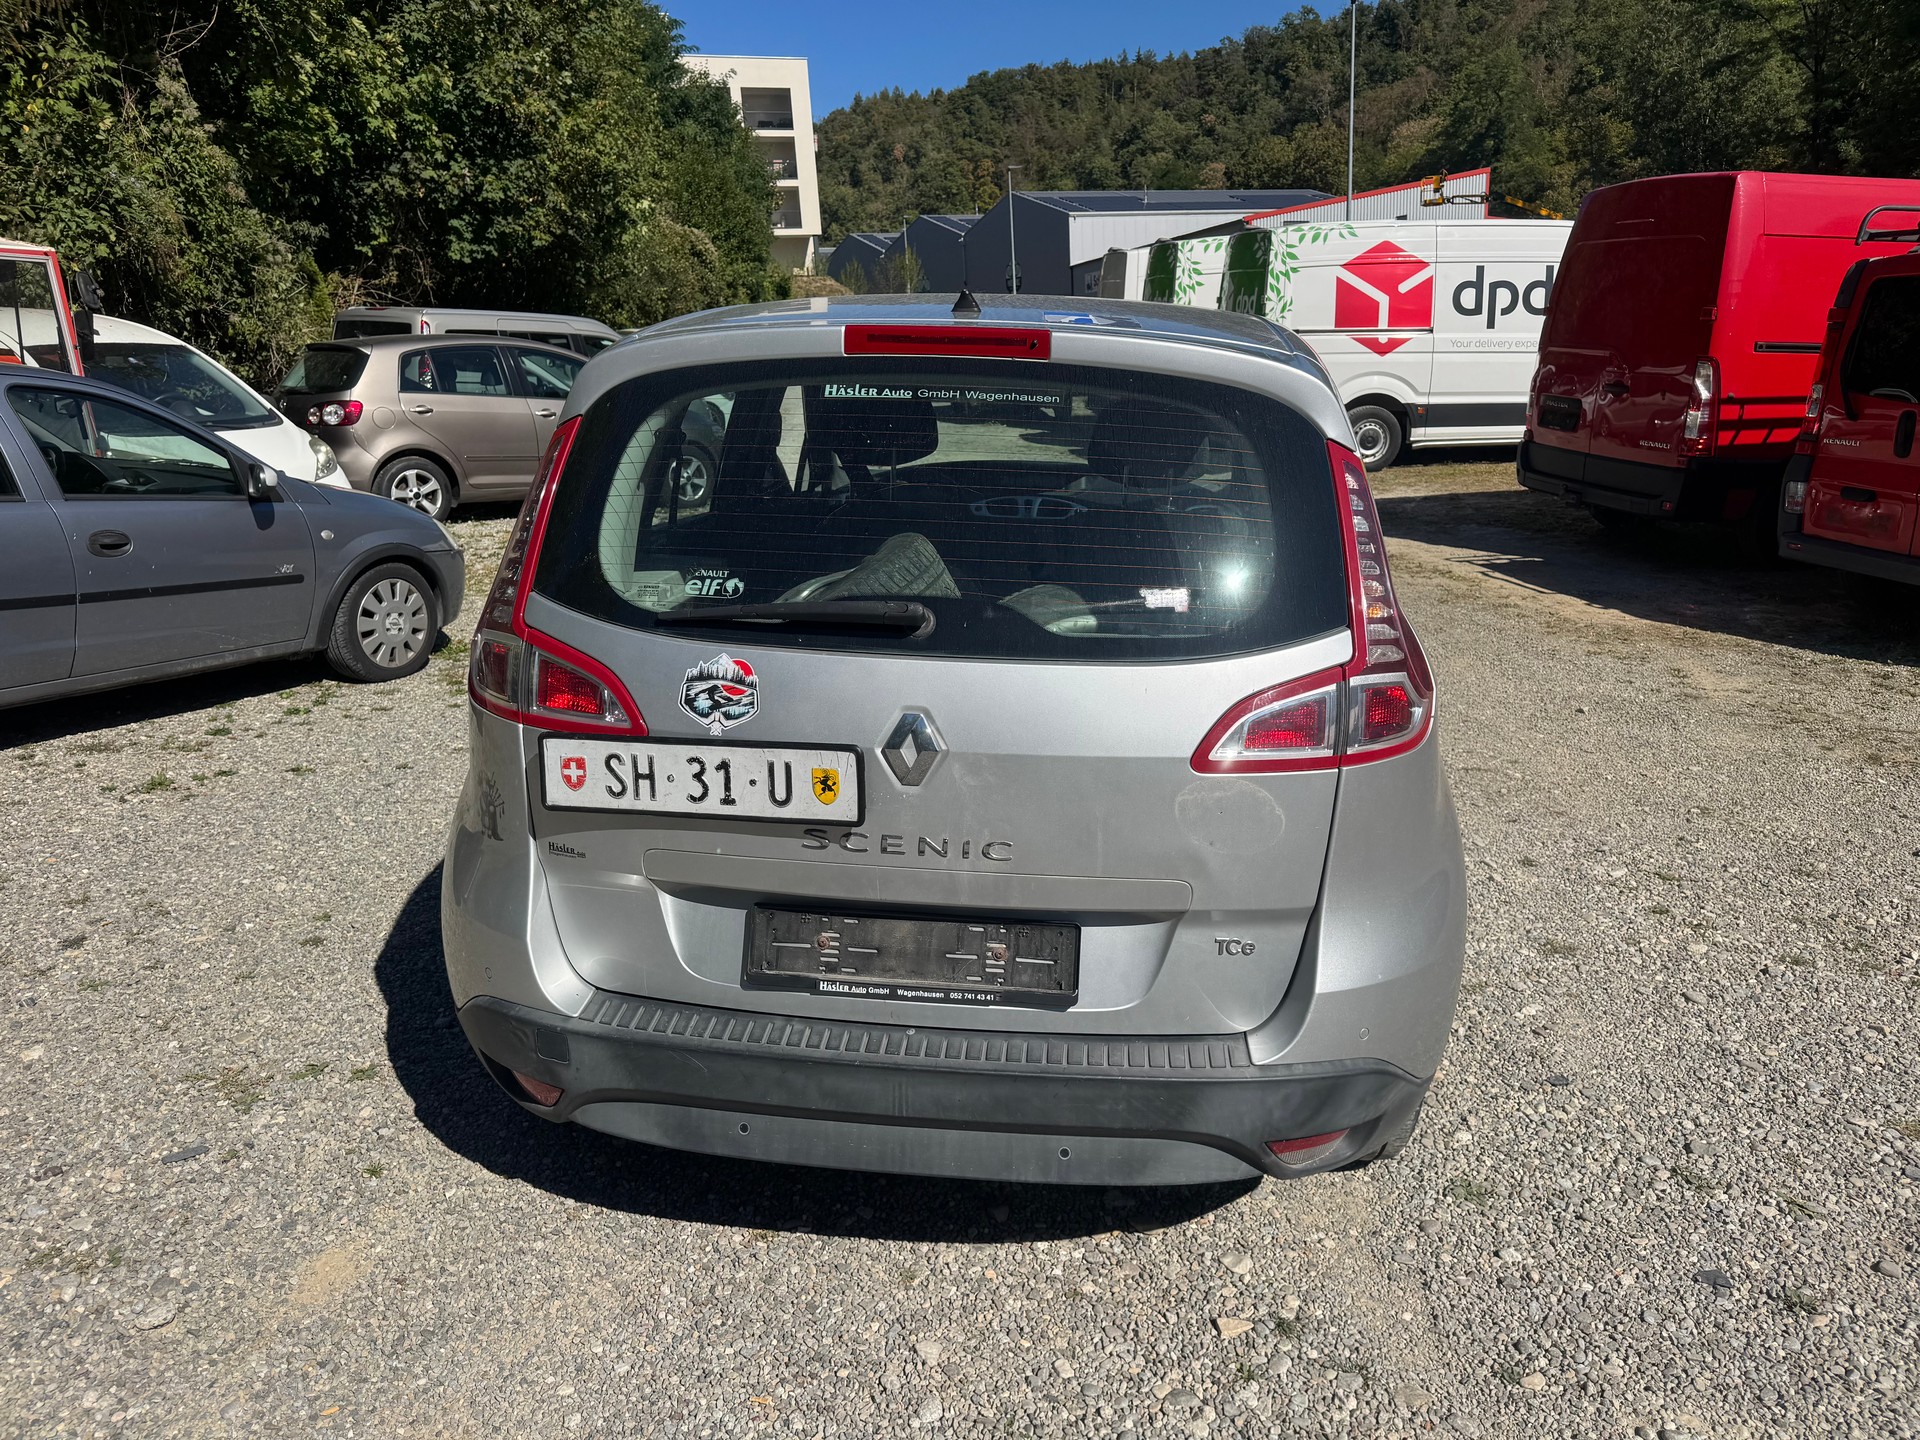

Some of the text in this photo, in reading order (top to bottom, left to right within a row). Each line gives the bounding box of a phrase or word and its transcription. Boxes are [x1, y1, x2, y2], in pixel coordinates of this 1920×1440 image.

[1452, 265, 1554, 329] dpd
[1450, 339, 1473, 348] Your
[1474, 339, 1513, 350] delivery
[881, 388, 913, 398] Auto
[917, 389, 960, 399] GmbH
[964, 390, 1060, 403] Wagenhausen
[1639, 440, 1671, 449] RENAULT
[1823, 438, 1860, 447] RENAULT
[685, 579, 723, 595] elf
[801, 828, 1014, 861] SCENIC
[1214, 938, 1256, 956] TCe
[851, 986, 867, 994] Auto
[868, 987, 890, 995] GmbH
[897, 989, 945, 998] Wagenhausen
